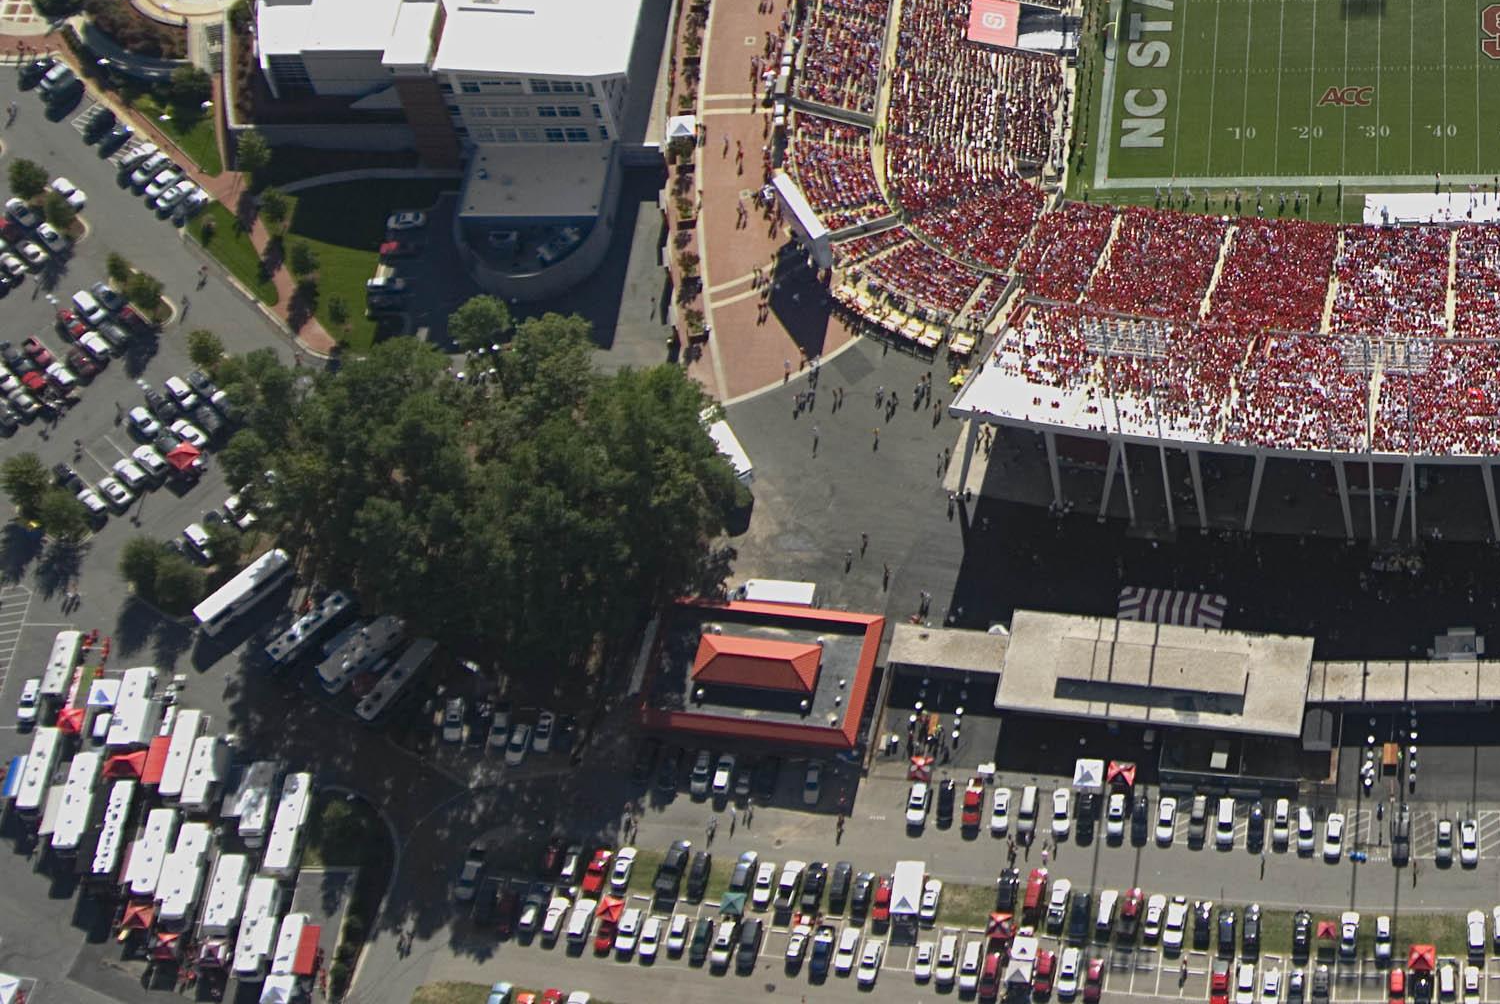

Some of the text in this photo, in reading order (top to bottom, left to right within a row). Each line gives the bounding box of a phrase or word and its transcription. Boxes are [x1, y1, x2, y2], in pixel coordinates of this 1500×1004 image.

[1316, 85, 1375, 107] ACC
[1120, 88, 1168, 148] NC
[1232, 126, 1257, 140] 10
[1299, 126, 1323, 139] 20
[1365, 125, 1390, 138] 30
[1432, 124, 1457, 137] 40
